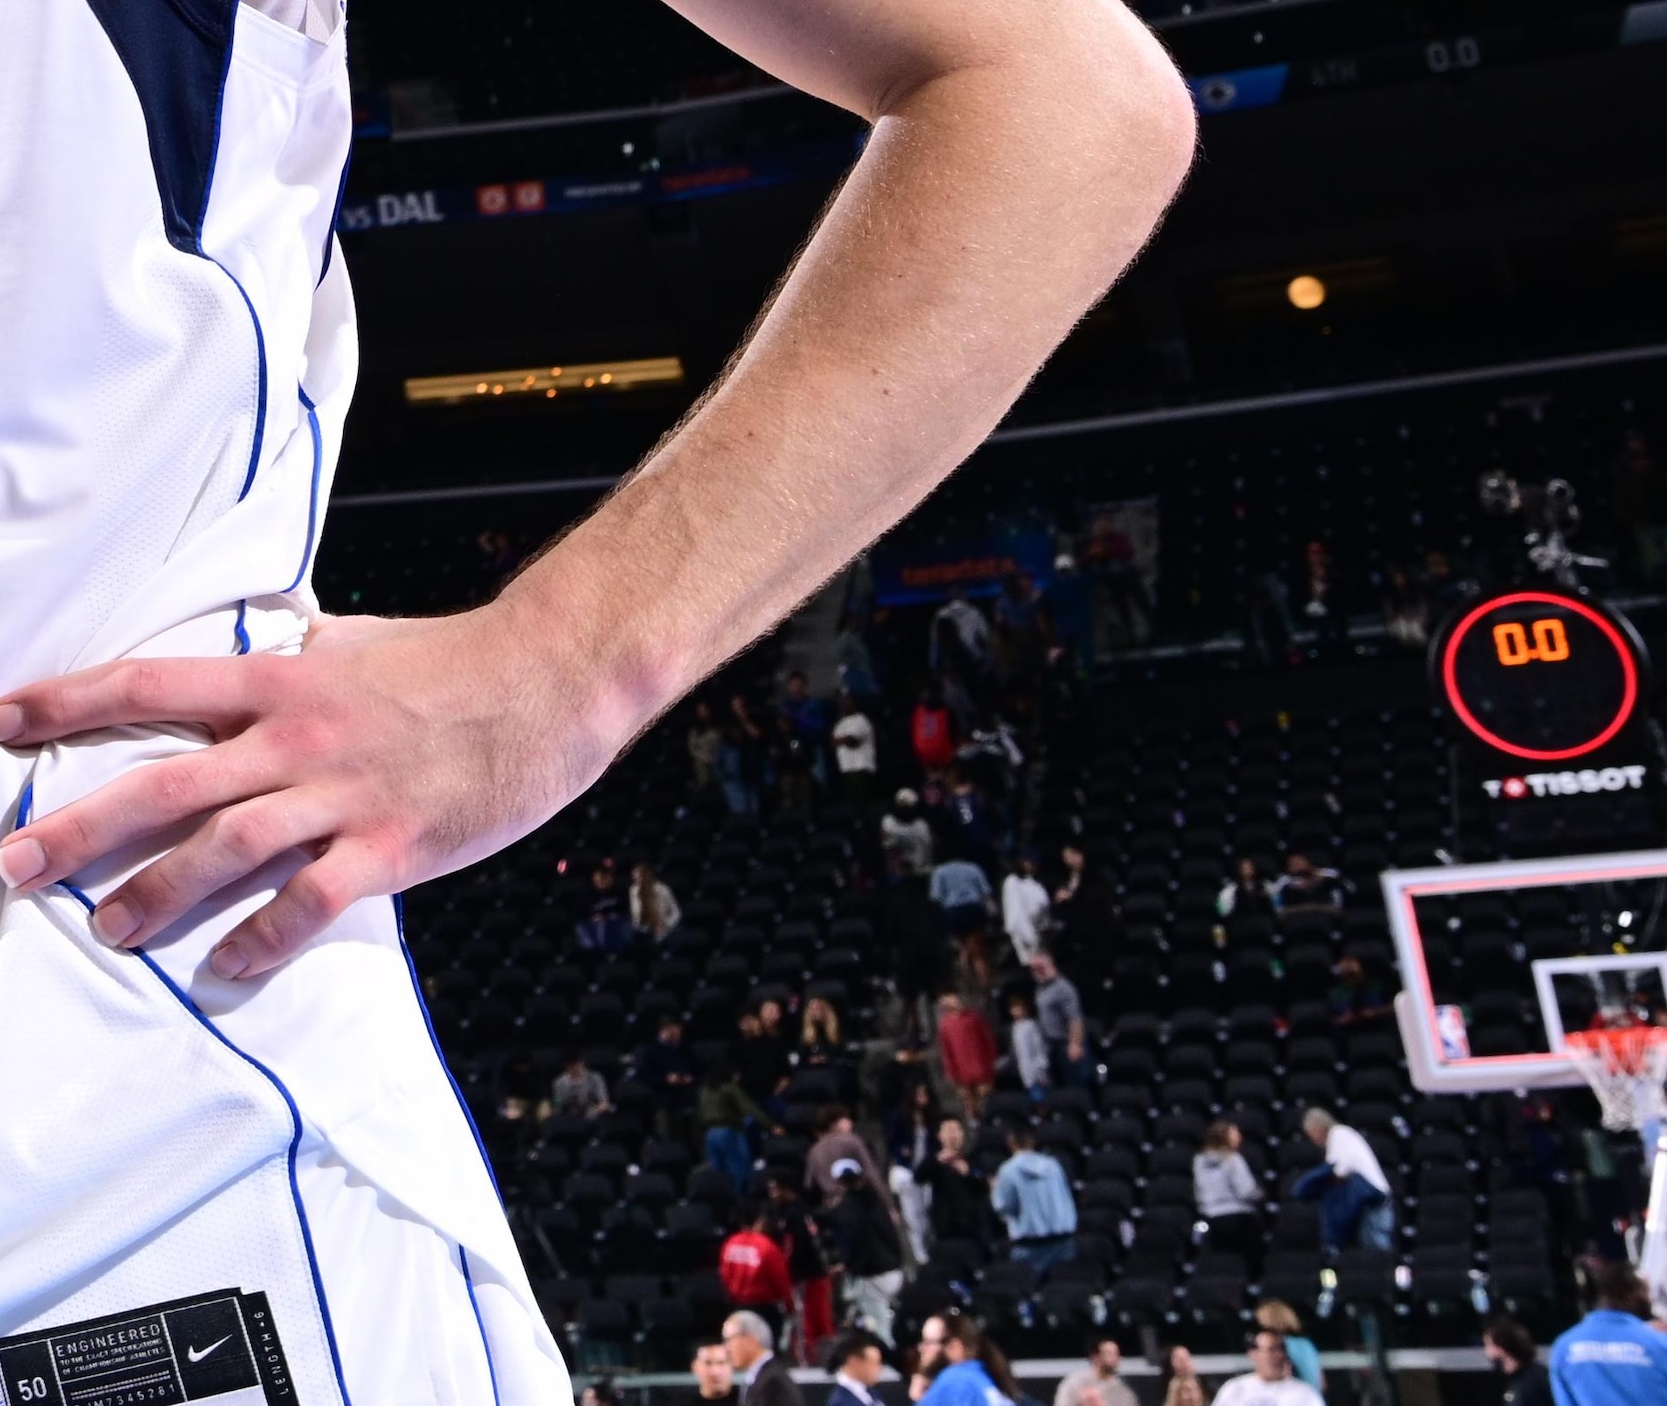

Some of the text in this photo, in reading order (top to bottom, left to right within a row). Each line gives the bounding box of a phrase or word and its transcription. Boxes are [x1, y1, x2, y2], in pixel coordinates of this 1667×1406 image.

[377, 189, 446, 227] DAL
[1492, 618, 1571, 667] 0.0
[1524, 764, 1648, 798] TISSOT
[55, 1323, 161, 1358] ENGINEERED
[260, 1332, 290, 1396] LENGTH
[17, 1375, 48, 1402] 50
